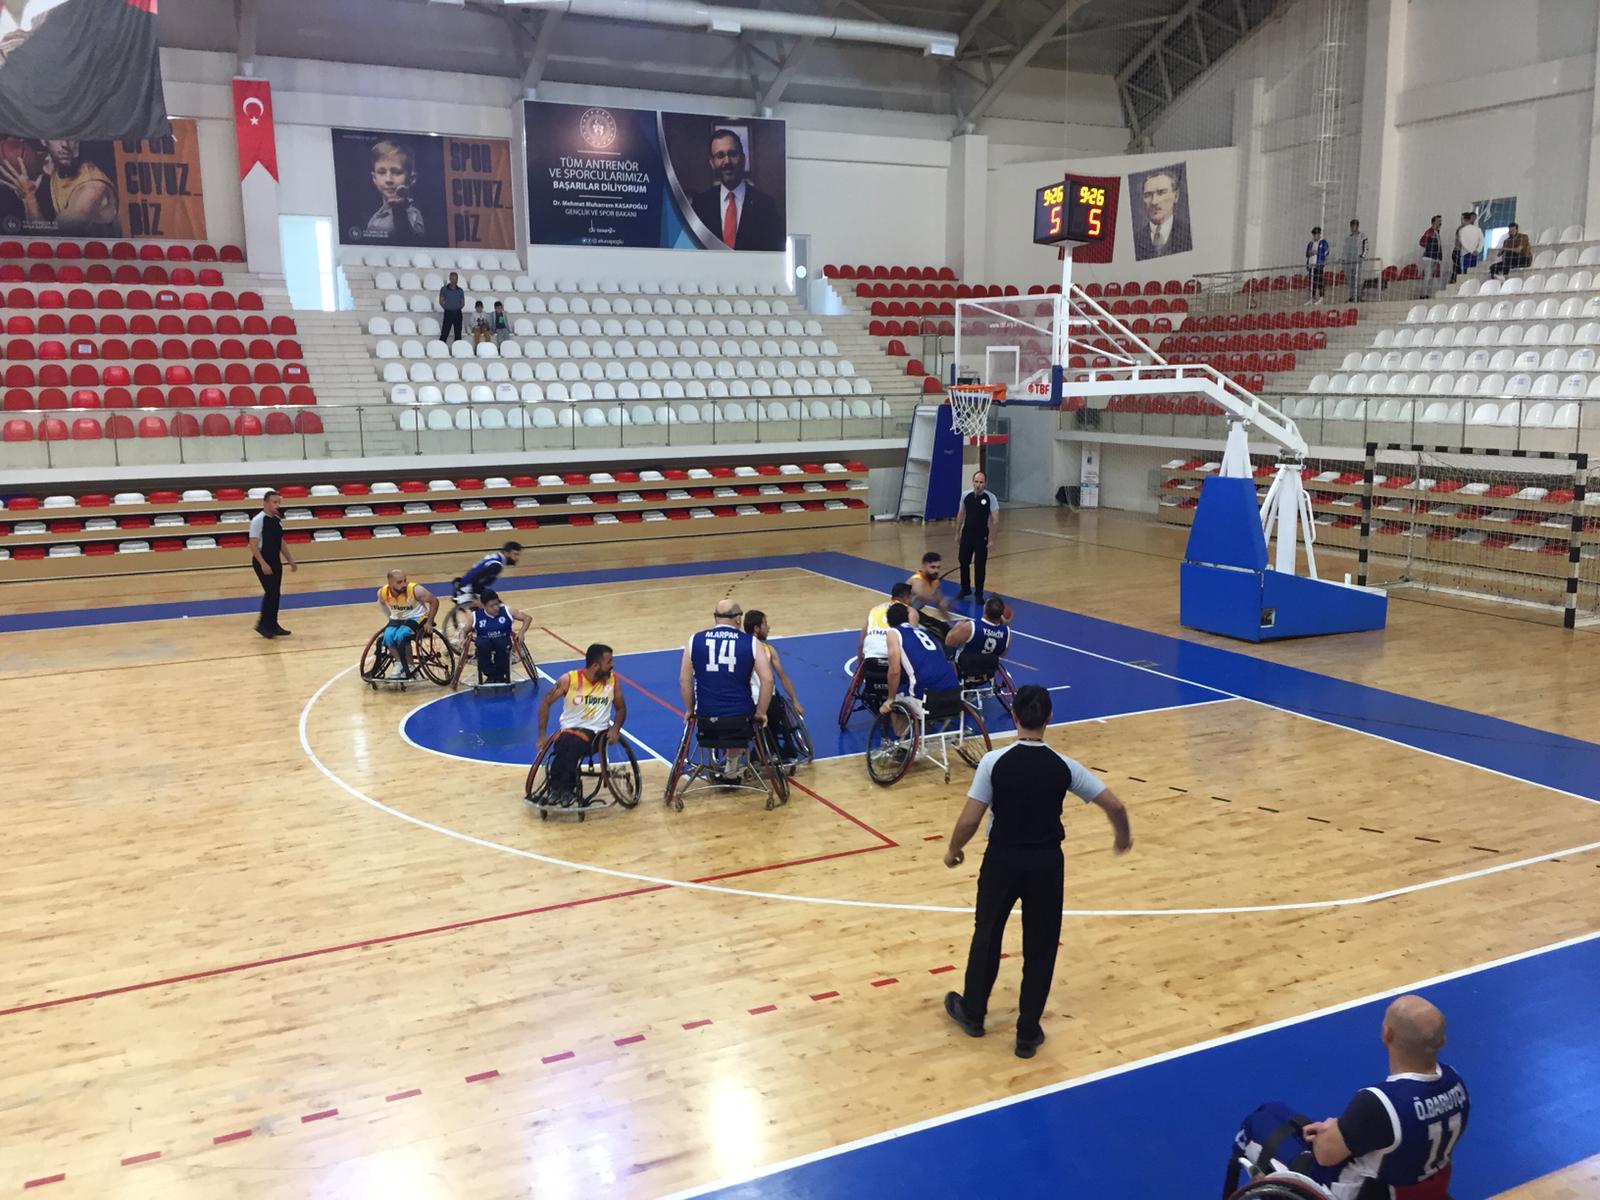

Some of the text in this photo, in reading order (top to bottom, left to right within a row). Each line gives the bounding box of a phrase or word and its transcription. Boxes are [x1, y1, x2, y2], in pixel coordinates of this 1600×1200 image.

[560, 156, 639, 171] TÜM ANTRENÖR
[548, 167, 650, 183] VE SPORCULARIMIZA
[553, 180, 647, 193] BAŞARILAR DİLİYORUM
[591, 209, 598, 217] VE
[615, 202, 648, 210] KASAPOĞLU
[1049, 206, 1062, 234] 5
[1088, 208, 1102, 236] 5
[1035, 384, 1050, 395] TBF
[705, 631, 739, 639] M.ARPAK
[913, 629, 937, 651] 8
[981, 638, 998, 655] 9
[705, 638, 737, 673] 14
